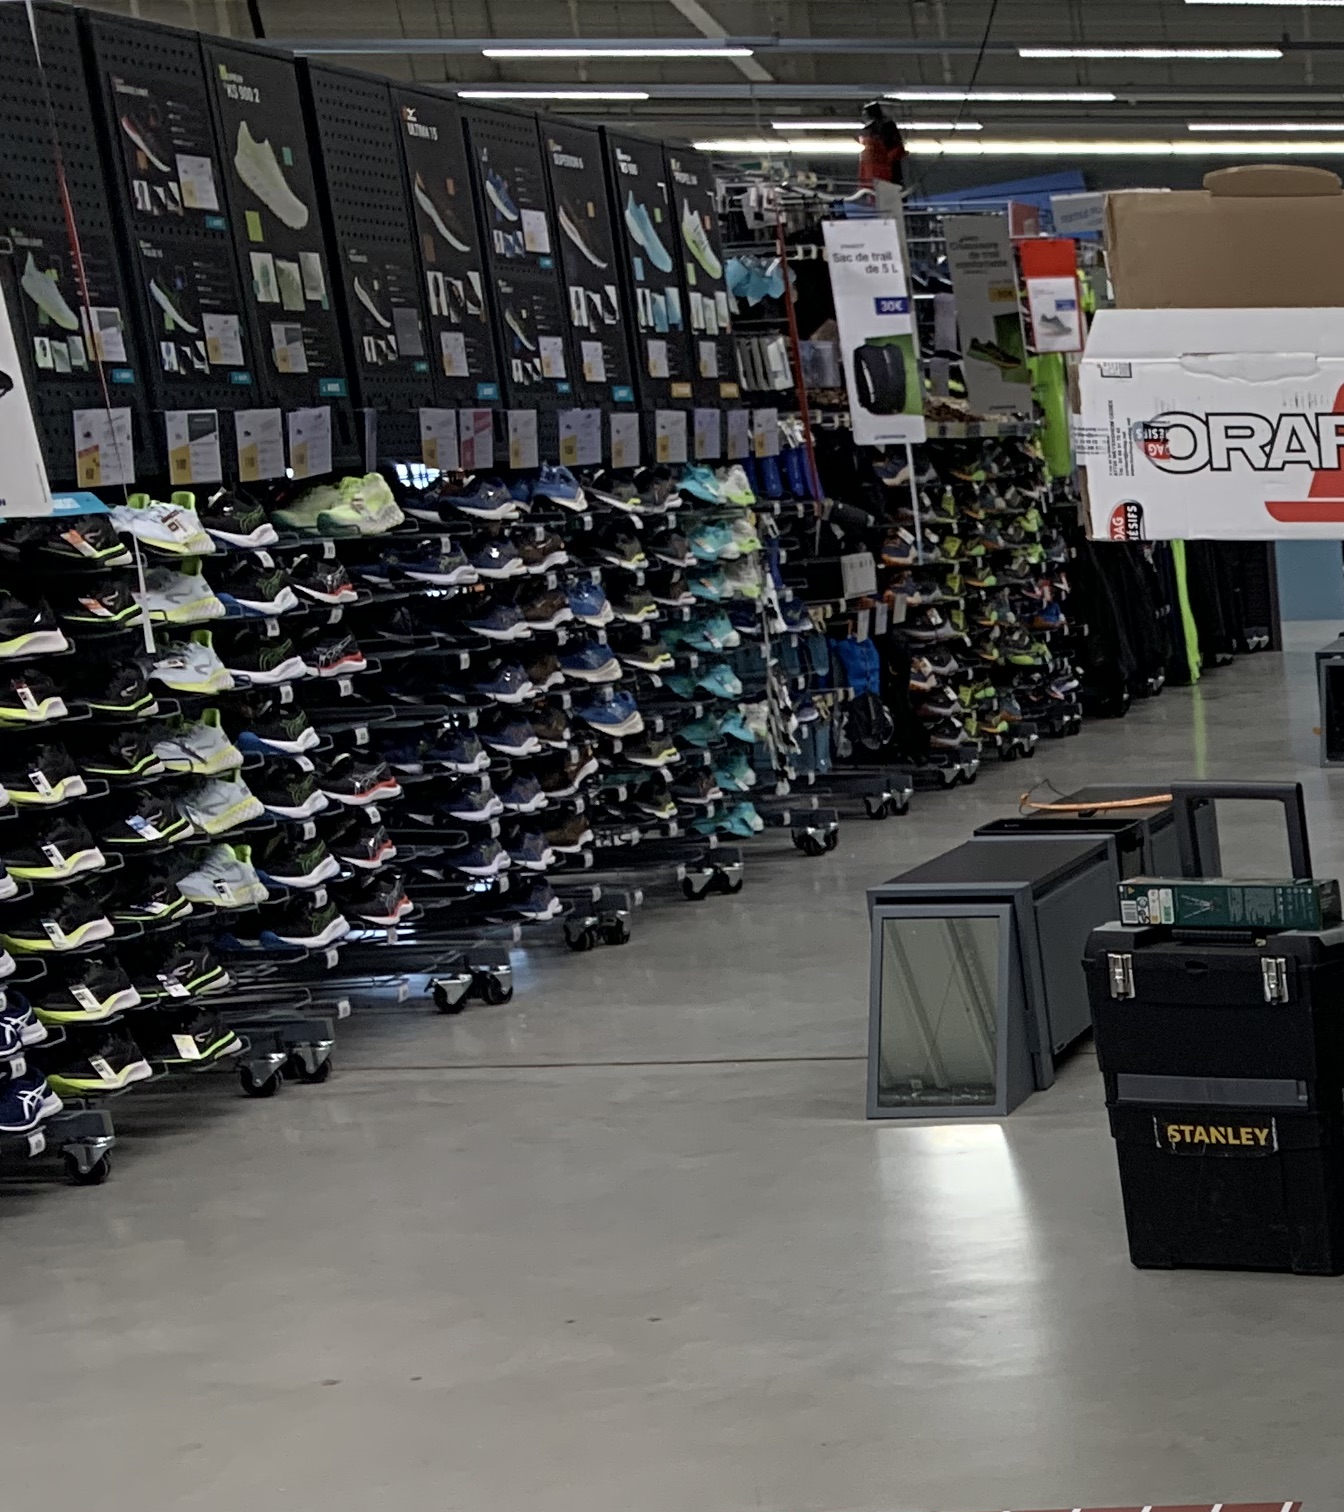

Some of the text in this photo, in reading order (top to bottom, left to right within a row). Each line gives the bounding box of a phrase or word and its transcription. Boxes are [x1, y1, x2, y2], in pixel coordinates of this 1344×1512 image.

[832, 252, 893, 264] Sac de trail
[865, 264, 898, 275] de 5 L
[880, 300, 904, 313] 30€
[1167, 1124, 1270, 1147] STANLEY
